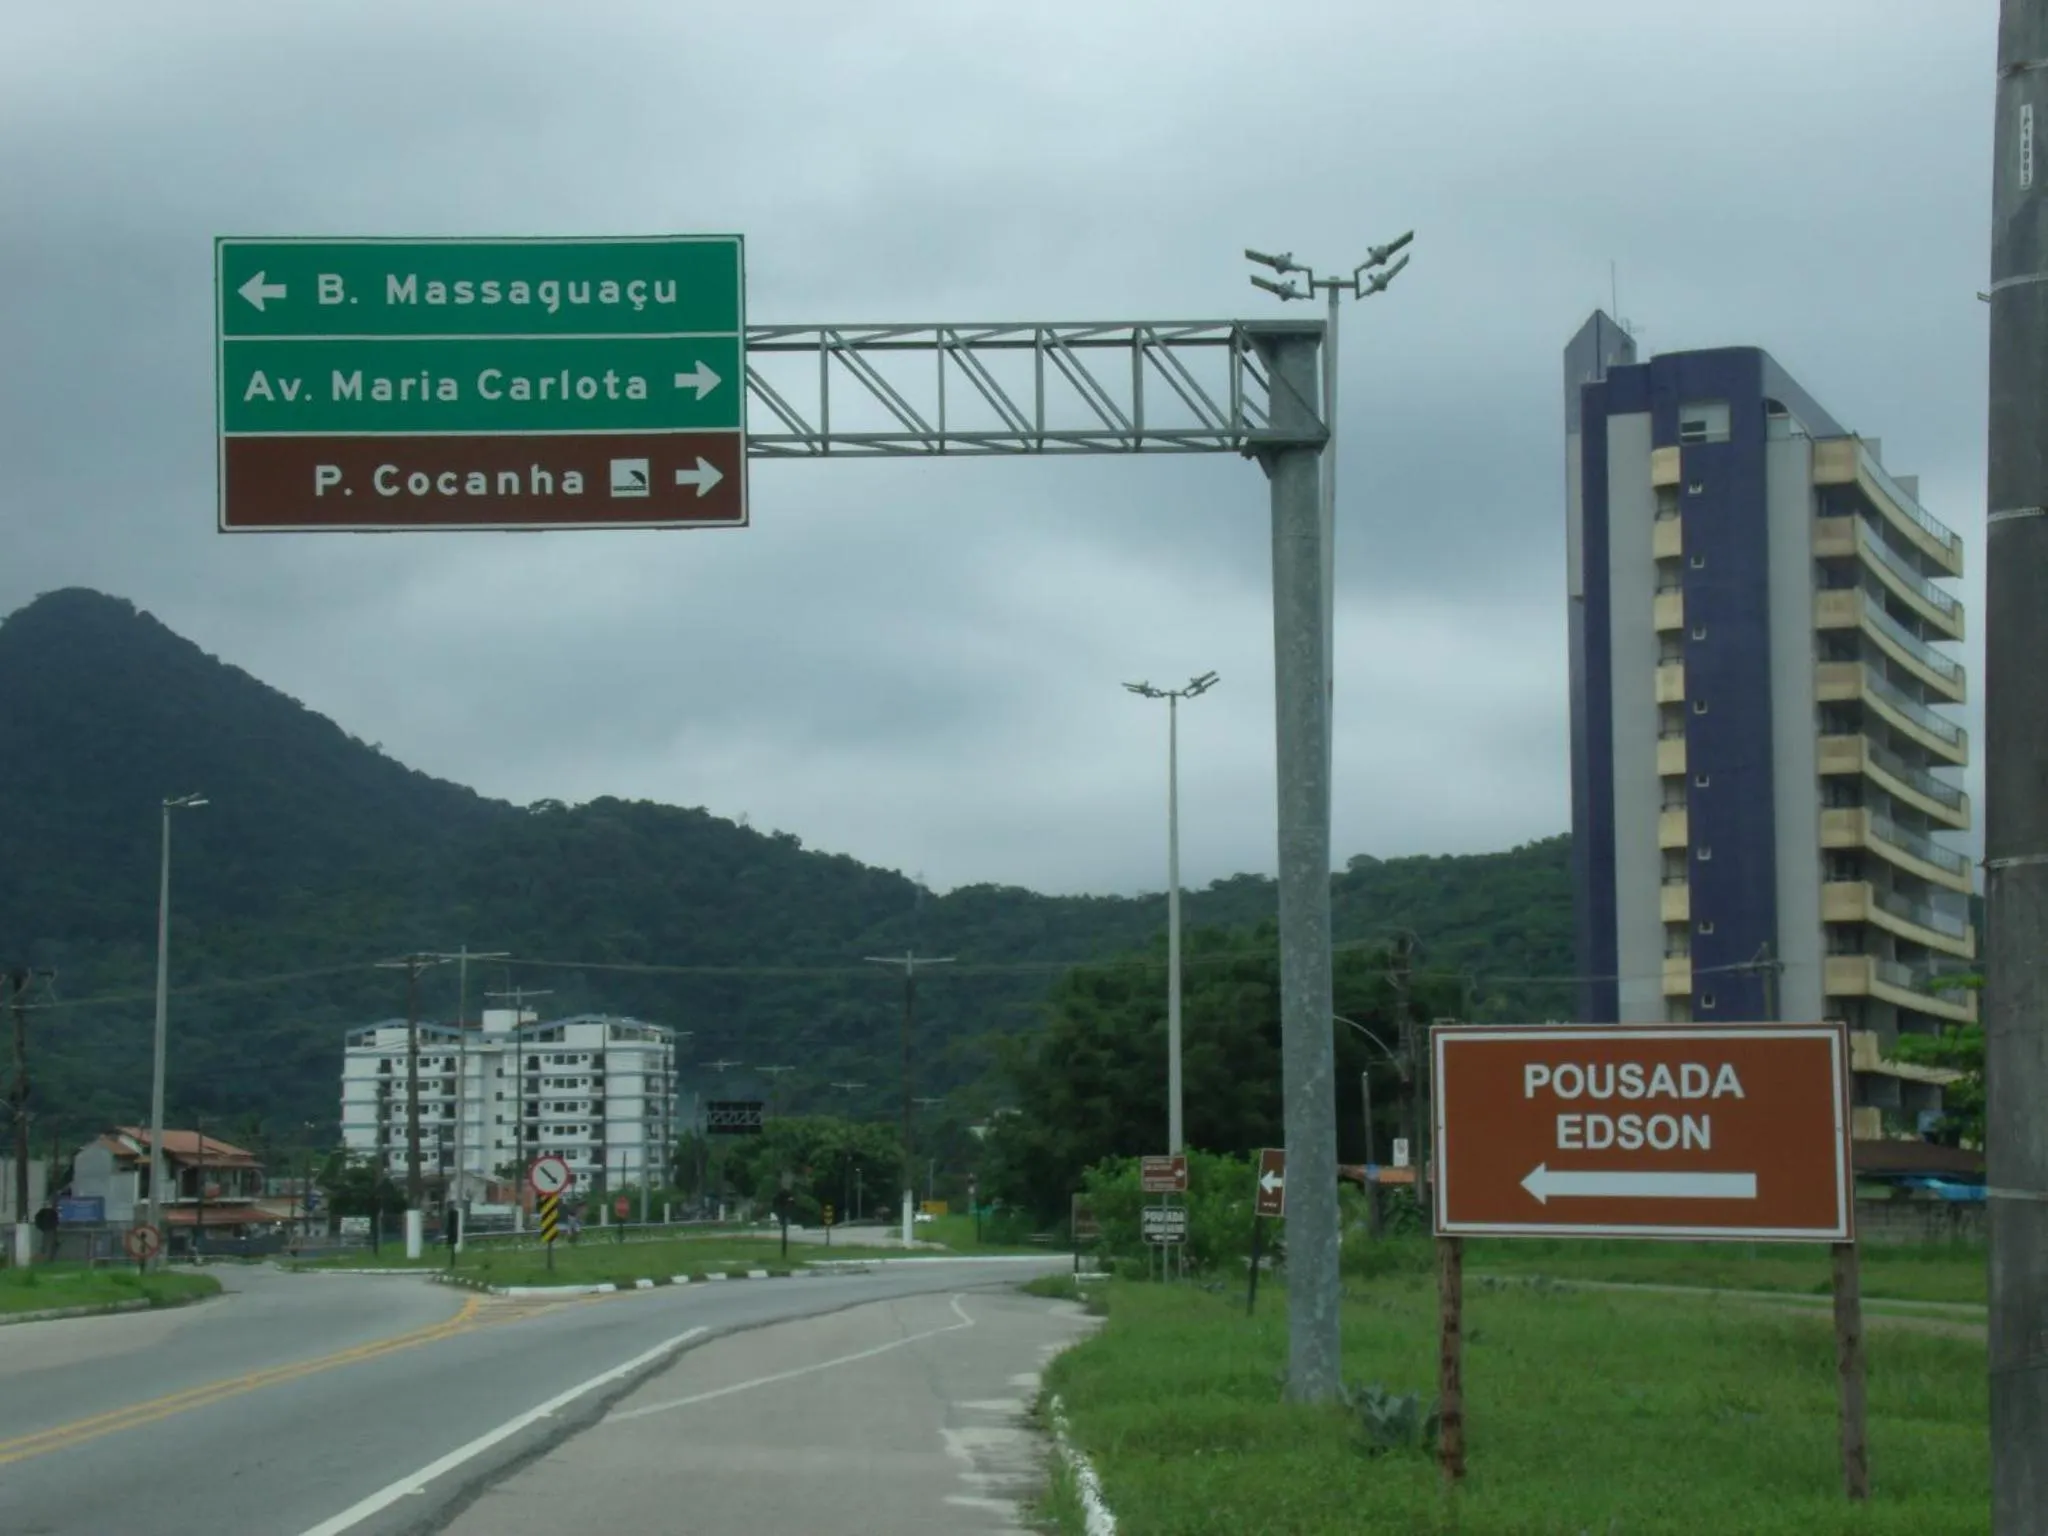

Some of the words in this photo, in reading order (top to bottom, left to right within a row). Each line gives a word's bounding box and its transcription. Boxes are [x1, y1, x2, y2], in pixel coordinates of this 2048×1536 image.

[318, 273, 358, 305] B.
[386, 274, 677, 314] Massaguaçu
[243, 370, 312, 401] Av.
[332, 370, 458, 401] Maria
[477, 368, 647, 401] Carlota
[315, 465, 352, 496] P.
[374, 464, 583, 496] Cocanha
[1524, 1063, 1745, 1099] POUSADA
[1556, 1114, 1711, 1150] EDSON
